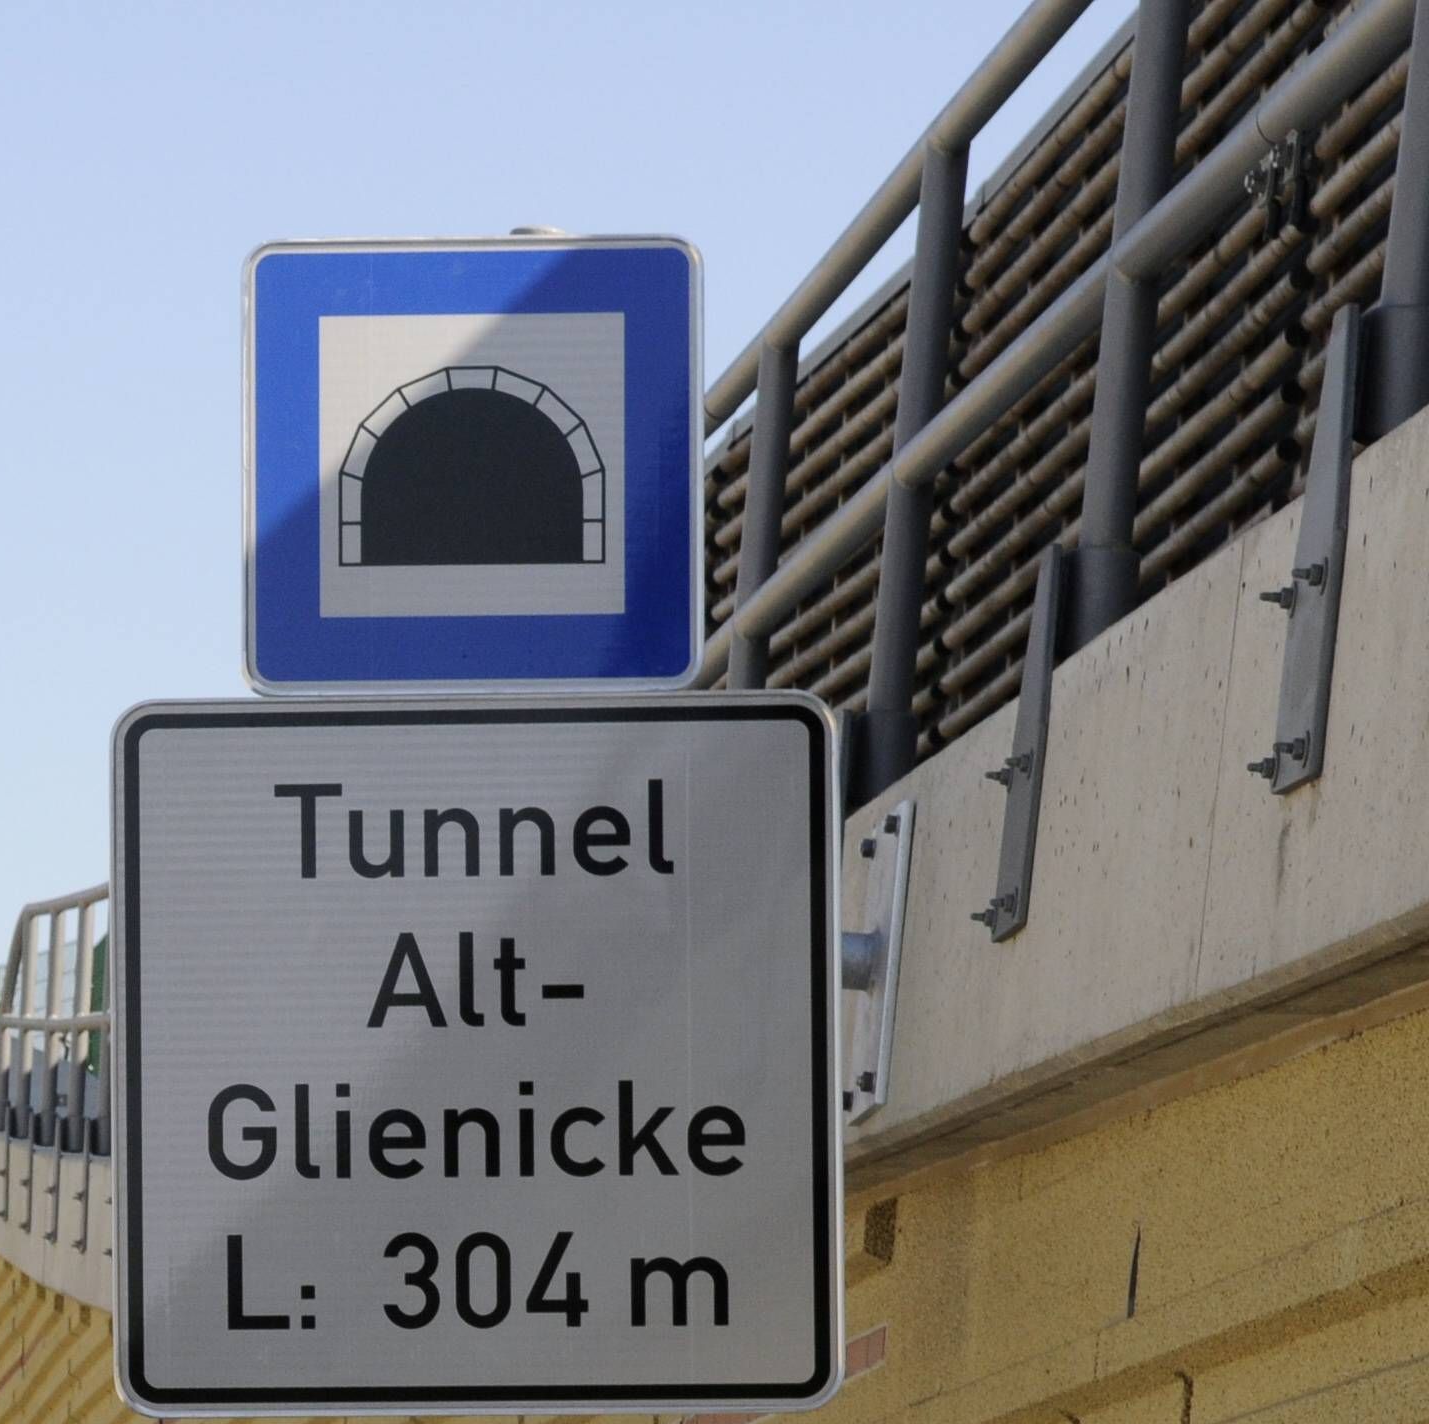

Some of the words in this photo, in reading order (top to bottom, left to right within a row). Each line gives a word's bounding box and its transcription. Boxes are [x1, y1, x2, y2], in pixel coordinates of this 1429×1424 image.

[273, 779, 675, 879] Tunnel
[366, 932, 585, 1029] Alt-
[207, 1080, 746, 1181] Glienicke
[226, 1234, 317, 1331] L:
[382, 1231, 590, 1330] 304
[629, 1256, 730, 1328] m
